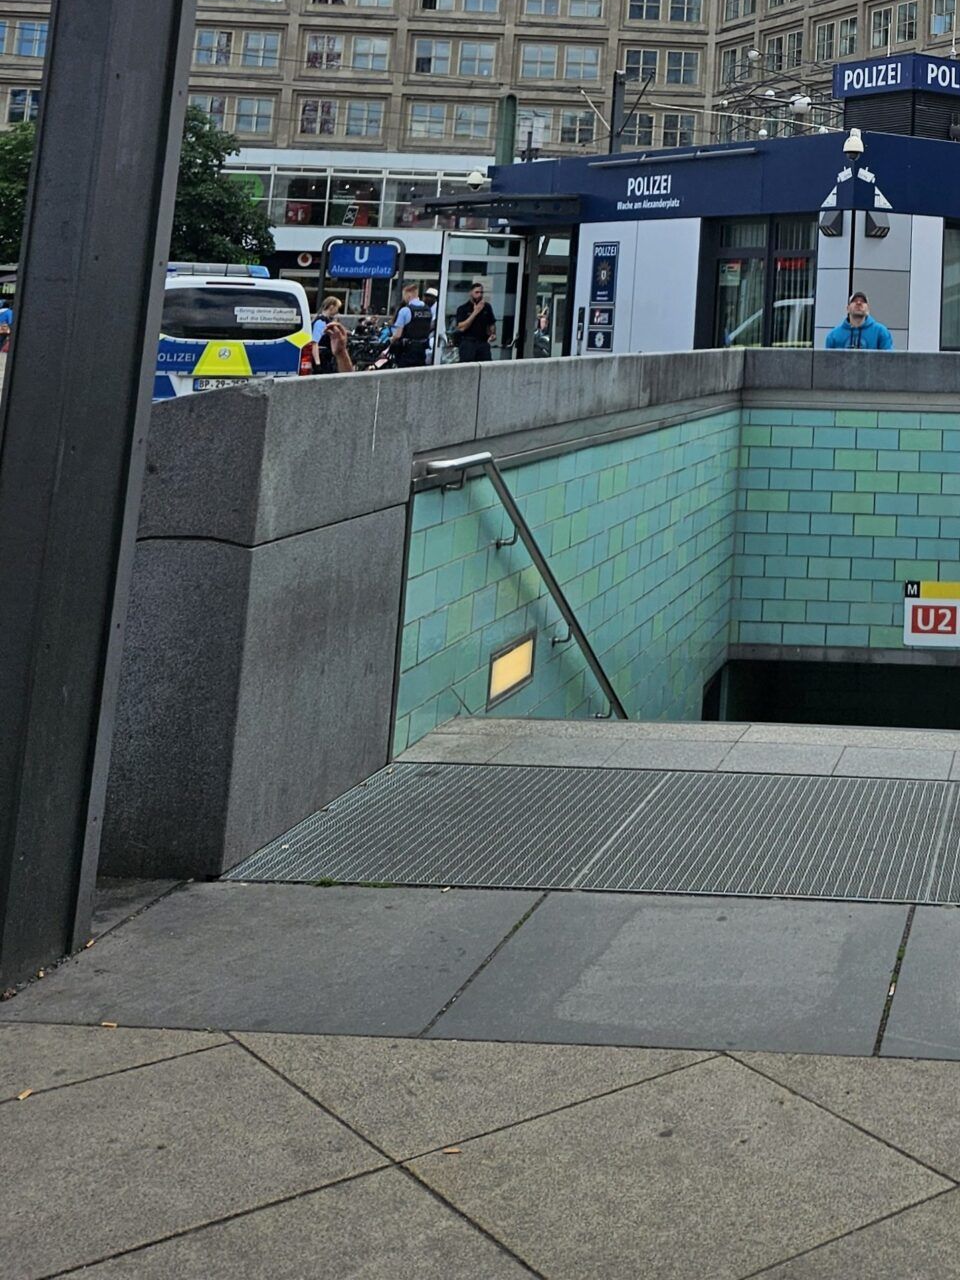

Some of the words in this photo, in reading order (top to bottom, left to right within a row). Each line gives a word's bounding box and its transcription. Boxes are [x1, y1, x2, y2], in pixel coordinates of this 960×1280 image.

[844, 63, 901, 90] POLIZEI
[627, 175, 672, 197] POLIZEI
[617, 201, 634, 210] Wache
[634, 201, 642, 209] am
[642, 198, 680, 210] Alexanderplatz
[355, 246, 370, 263] U
[594, 246, 617, 256] POLIZEI
[331, 265, 392, 276] Alexanderplatz
[157, 353, 196, 362] OLIZEI
[908, 584, 918, 594] M
[917, 607, 952, 631] U2
